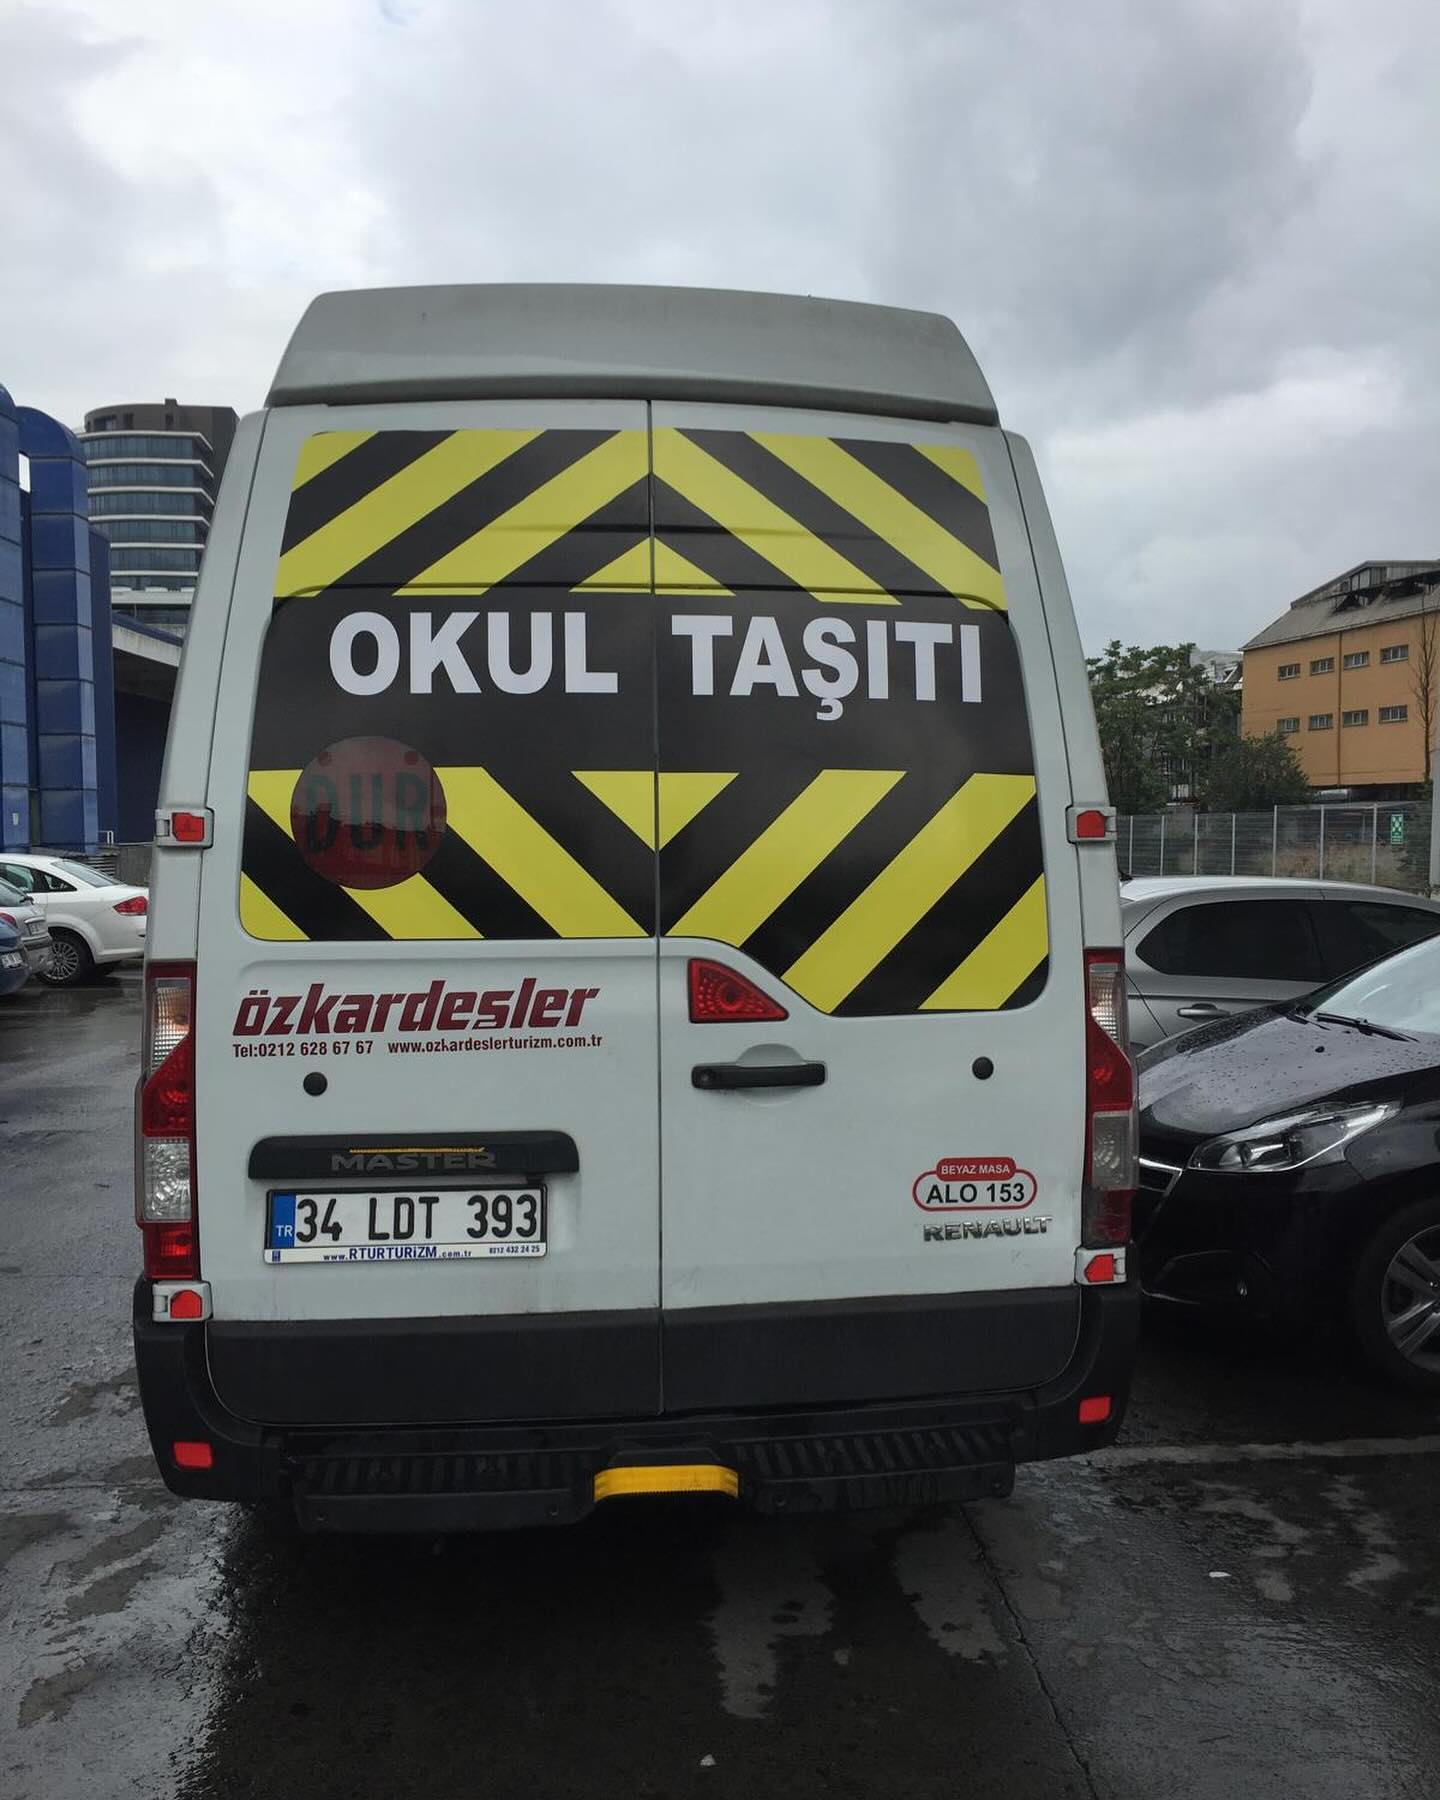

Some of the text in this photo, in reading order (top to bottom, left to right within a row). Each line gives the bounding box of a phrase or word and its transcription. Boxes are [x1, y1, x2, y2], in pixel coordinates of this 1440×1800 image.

[329, 611, 983, 722] OKUL TAŞITI
[306, 773, 429, 854] DUR
[232, 1034, 603, 1058] Tel:0212 628 67 67 www.ozkardeslerturizm.com.tr
[331, 1152, 497, 1171] MASTER
[941, 1164, 1010, 1175] BEYAZ MASA
[926, 1183, 1025, 1204] ALO 153
[275, 1194, 537, 1243] TR 34 LDT 393
[923, 1216, 1053, 1242] RENAULT
